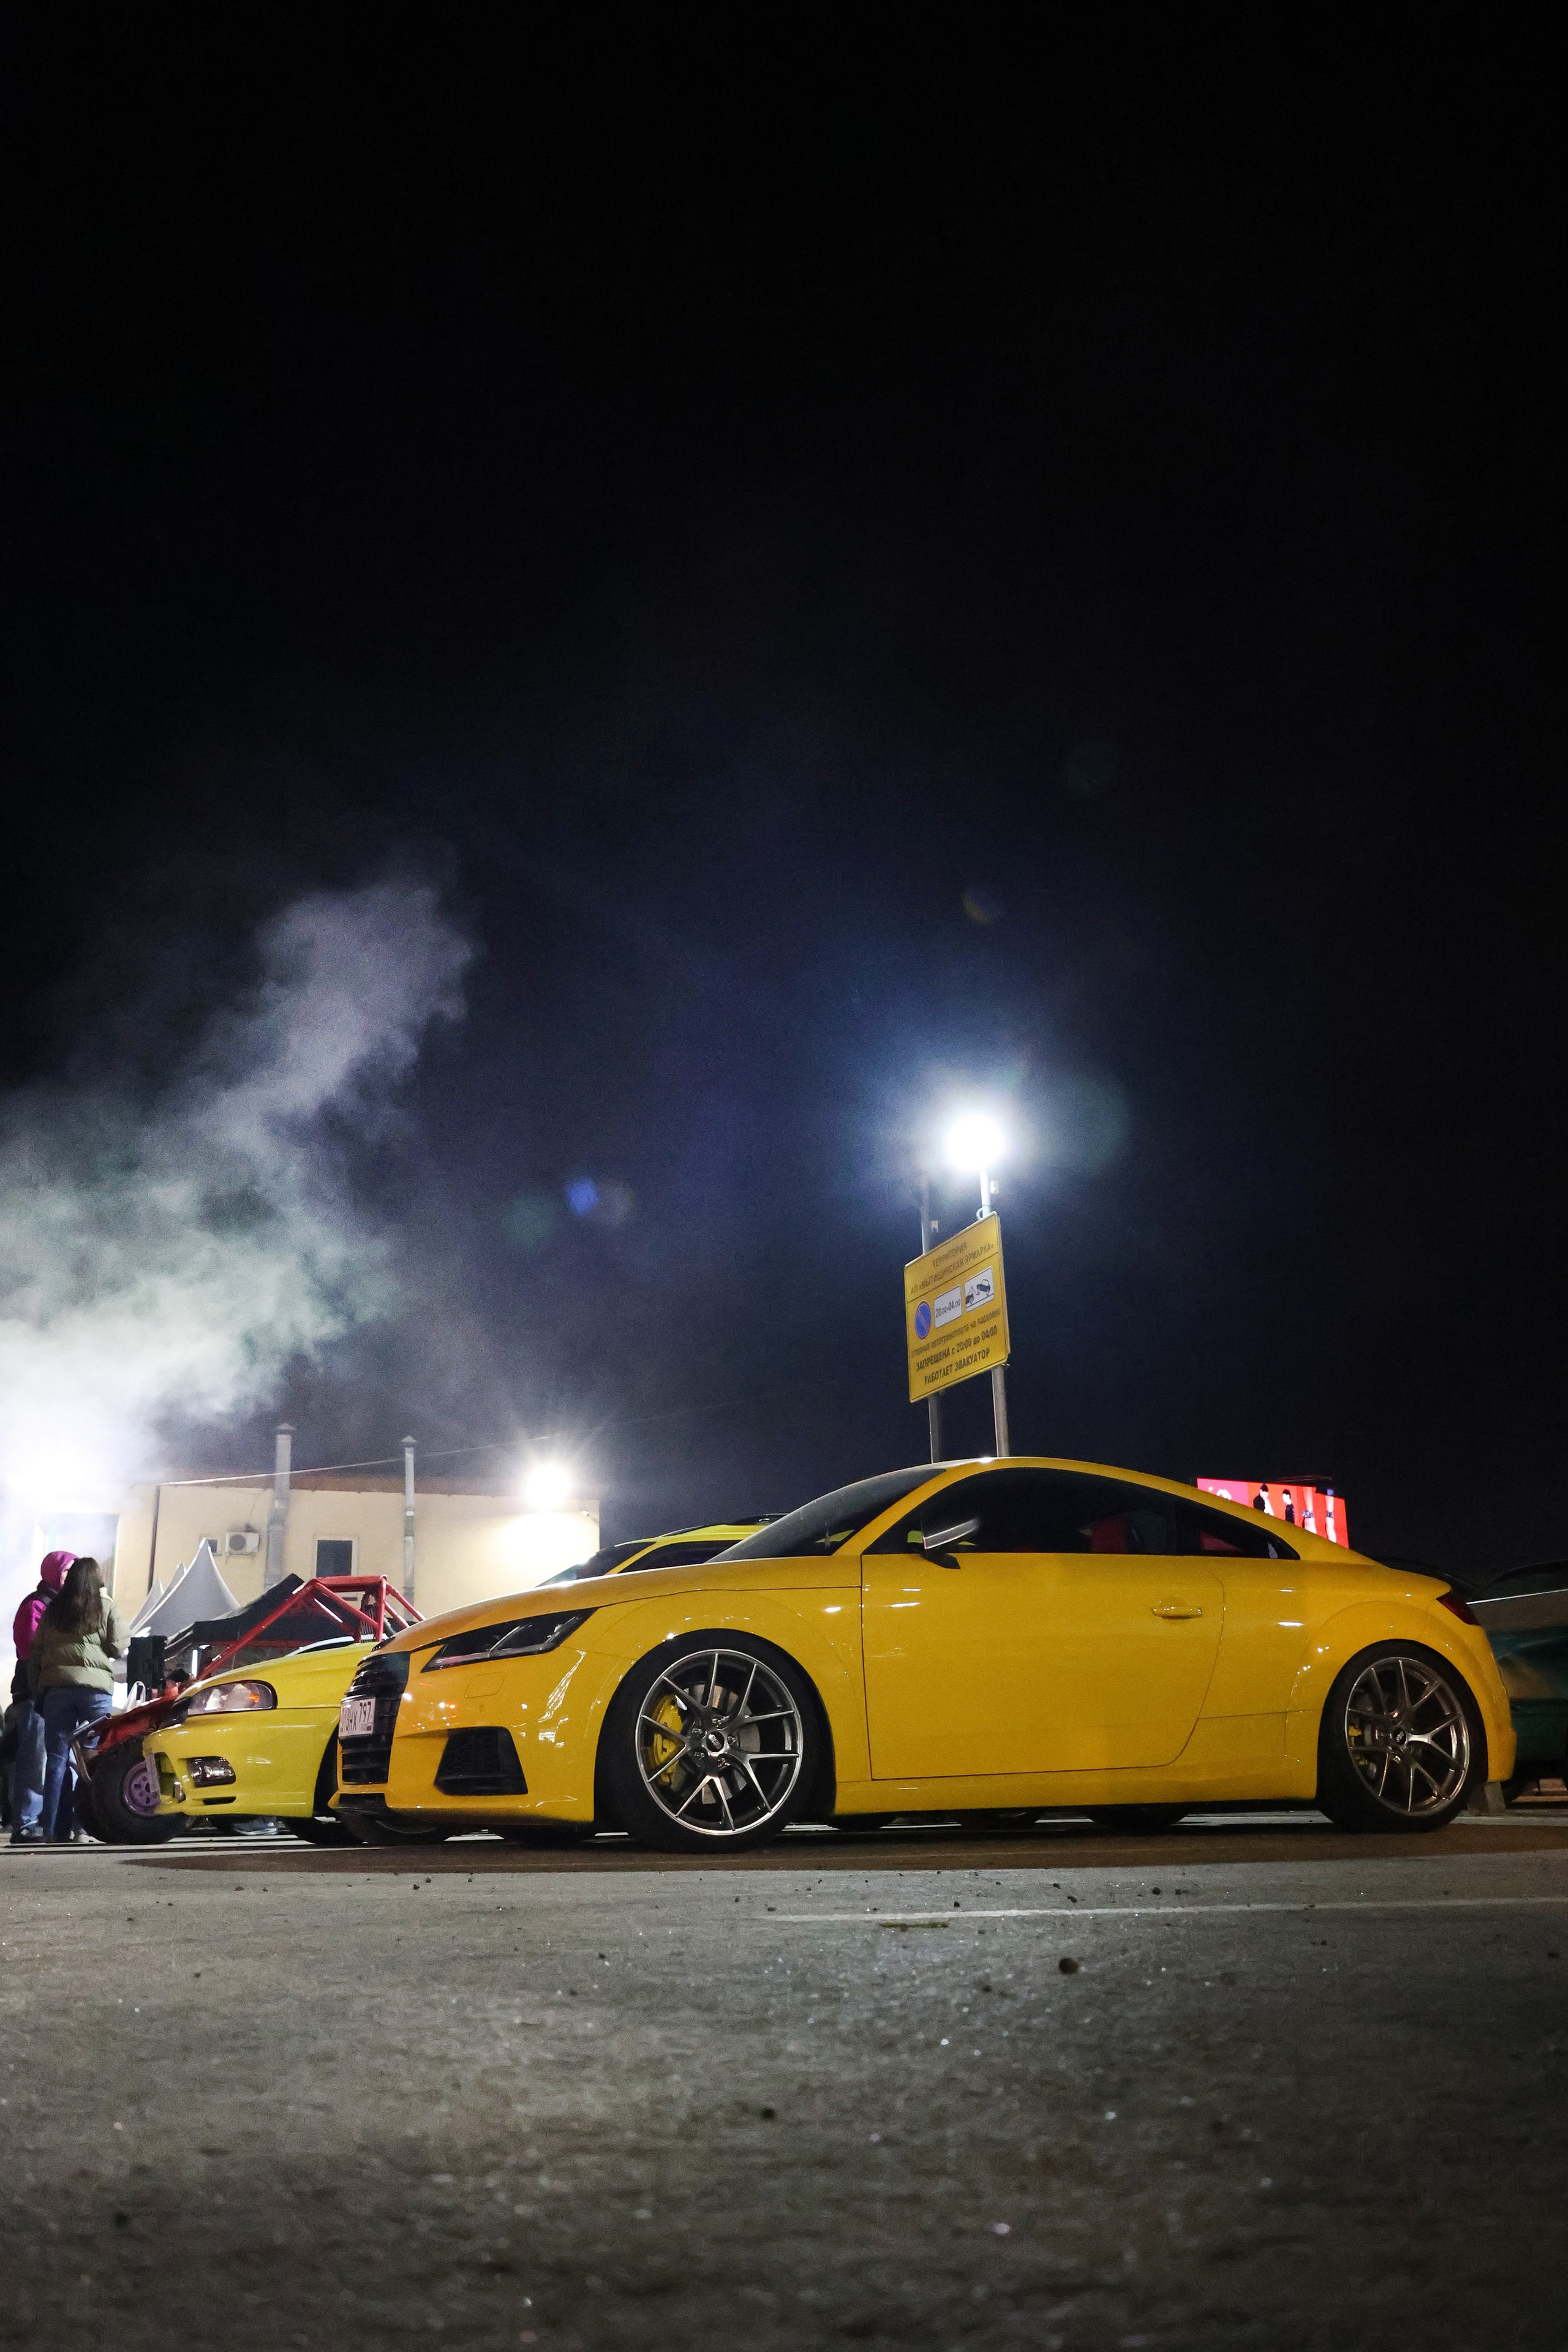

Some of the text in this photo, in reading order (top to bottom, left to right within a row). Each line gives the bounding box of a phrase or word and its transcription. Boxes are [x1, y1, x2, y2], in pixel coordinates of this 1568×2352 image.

[916, 1347, 950, 1371] ЗАПРЕЩЕНА
[924, 1346, 990, 1385] РАБОТАЕТ ЭВАКУАТОР
[360, 1702, 371, 1723] 797
